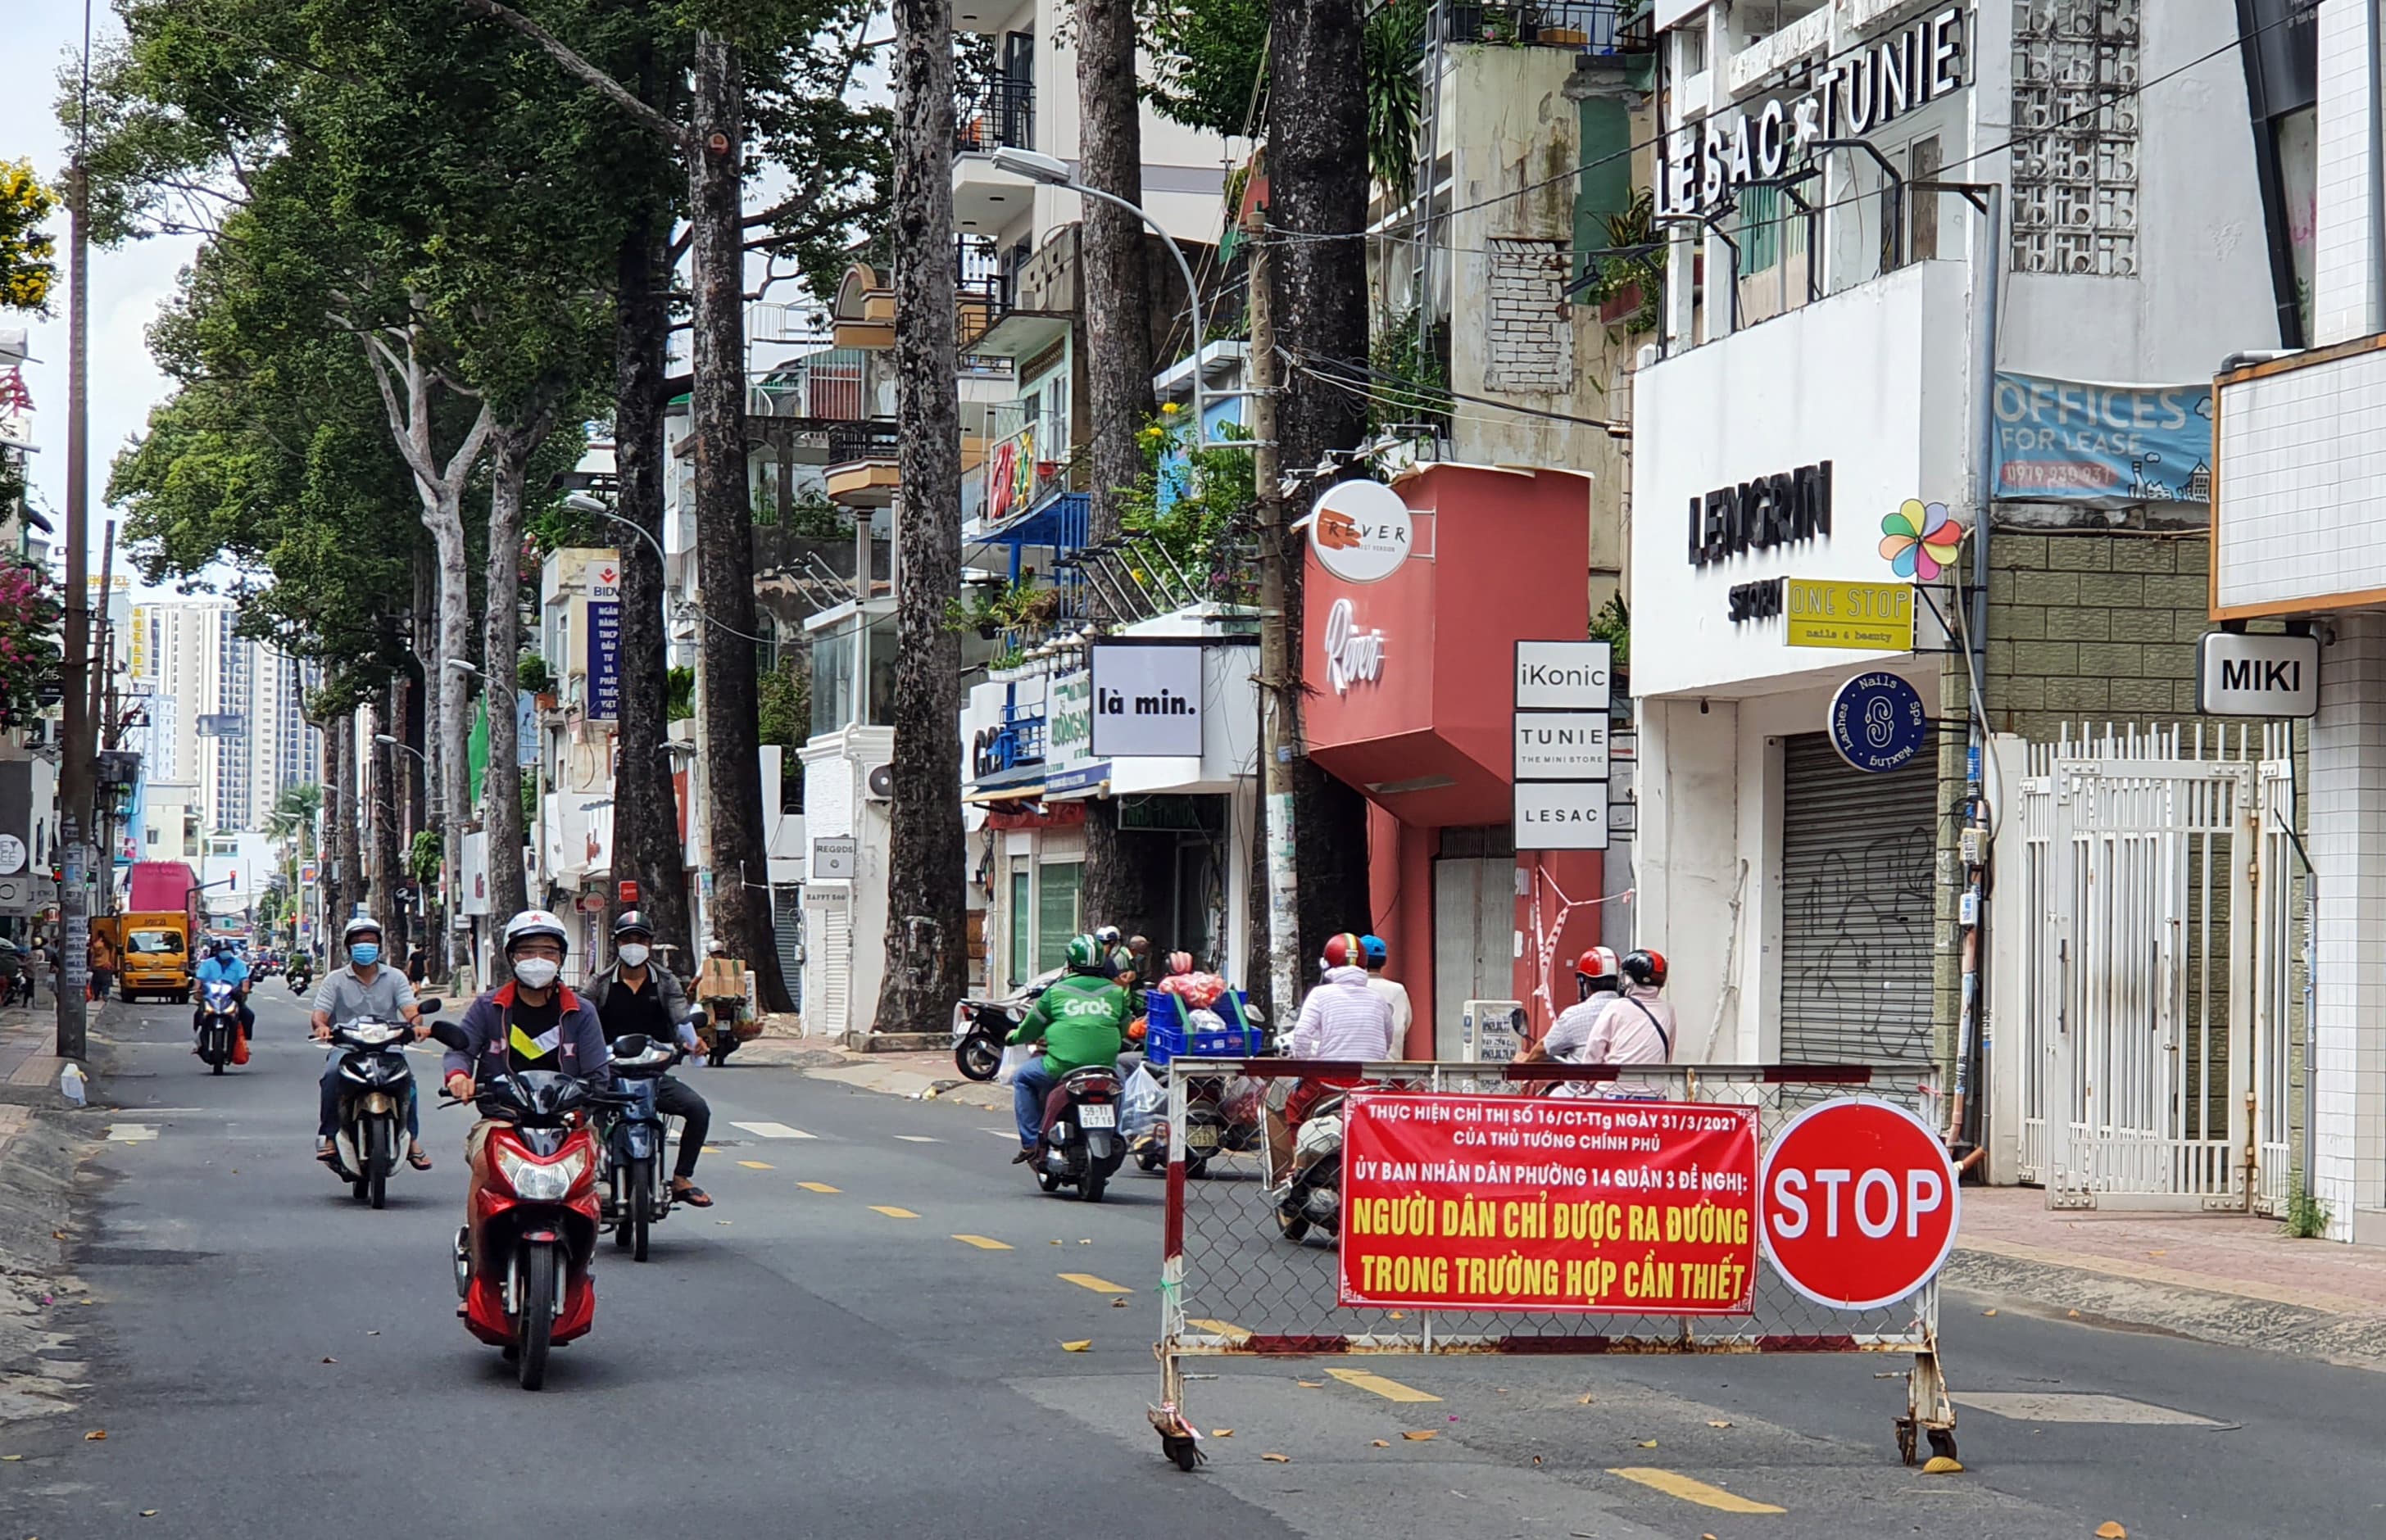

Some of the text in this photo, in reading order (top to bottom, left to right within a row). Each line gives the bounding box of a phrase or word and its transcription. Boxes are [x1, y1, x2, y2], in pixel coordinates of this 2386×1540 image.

[1656, 7, 1963, 220] LESAC TUNIE
[1994, 380, 2186, 430] OFFICES
[2001, 427, 2143, 456] FOR LEASE
[2007, 464, 2044, 483] 0979
[1329, 522, 1406, 543] REVER
[1791, 585, 1909, 618] ONE STOP
[1806, 629, 1838, 640] nails
[1855, 630, 1893, 643] beauty
[1522, 664, 1606, 686] iKonic
[1858, 674, 1898, 690] Nails
[2222, 659, 2301, 692] MIKI
[1099, 687, 1125, 715] là
[1135, 688, 1196, 715] min.
[1909, 701, 1922, 727] Spa
[1521, 729, 1604, 745] TUNIE
[1835, 703, 1854, 752] Lashes
[1522, 755, 1604, 763] THE MINI STORE
[1869, 745, 1914, 768] Waxing
[1526, 808, 1599, 822] LESAC
[1064, 996, 1113, 1017] Grab
[1368, 1103, 1737, 1131] THỰC HIỆN CHỈ THỊ SỐ 16/CT-TTg NGÀY 31/3/2021
[1454, 1126, 1660, 1152] CỦA THỦ TƯỚNG CHÍNH PHỦ
[1355, 1155, 1748, 1196] ỦY BAN NHÂN DÂN PHƯỜNG 14 QUẬN 3 ĐỀ NGHỊ:
[1772, 1167, 1943, 1239] STOP
[1353, 1190, 1749, 1248] NGƯỜI DÂN CHỈ ĐƯỢC RA ĐƯỜNG
[1361, 1249, 1745, 1305] TRONG TRƯỜNG HỢP CẦN THIẾT
